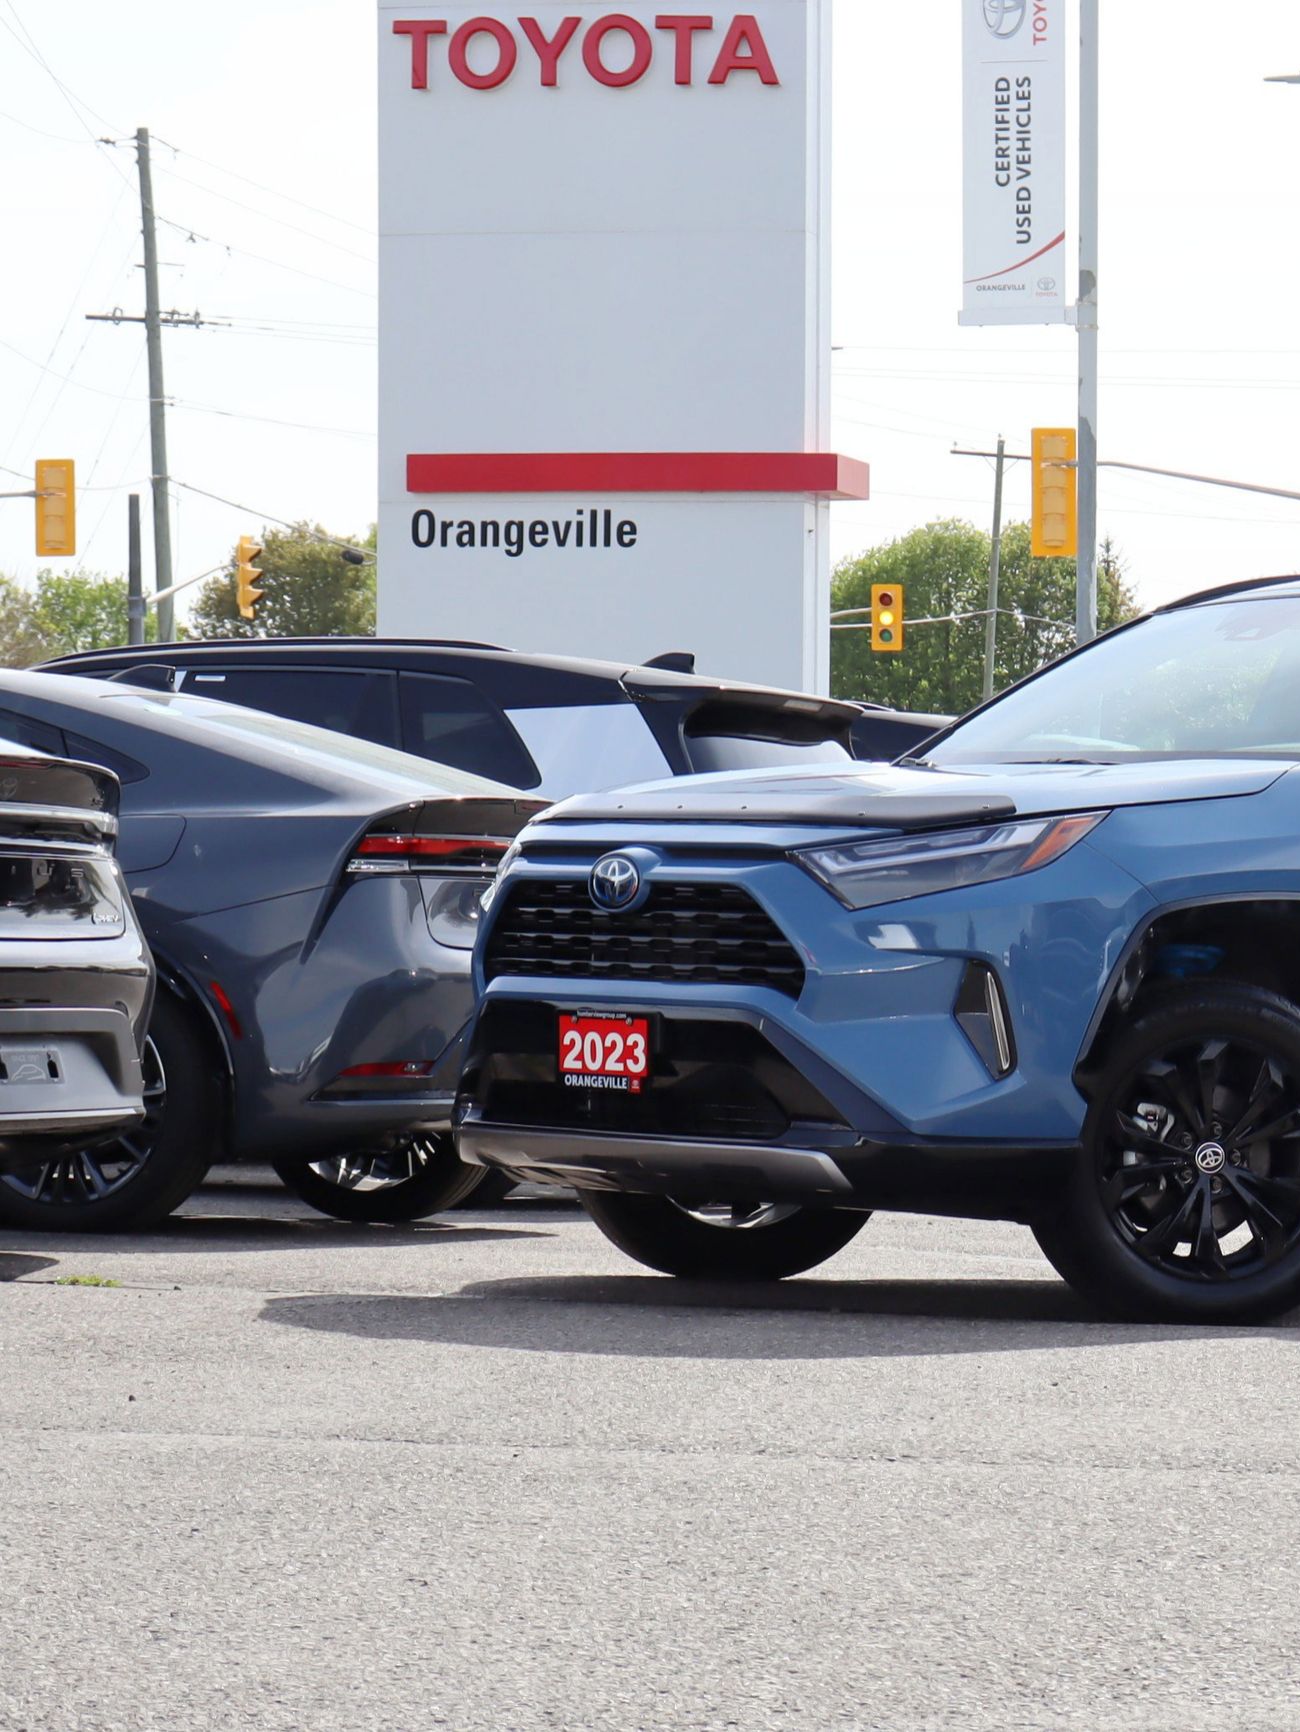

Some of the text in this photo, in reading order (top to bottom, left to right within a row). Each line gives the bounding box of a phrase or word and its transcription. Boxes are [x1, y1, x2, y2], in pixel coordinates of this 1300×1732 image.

[1032, 0, 1048, 46] TOY
[392, 13, 781, 90] TOYOTA
[994, 76, 1011, 188] CERTIFIED
[1016, 75, 1032, 244] USED VEHICLES
[976, 283, 1026, 292] ORANGEVILLE
[410, 508, 638, 558] Orangeville
[563, 1030, 646, 1073] 2023
[564, 1074, 627, 1089] ORANGEVILLE
